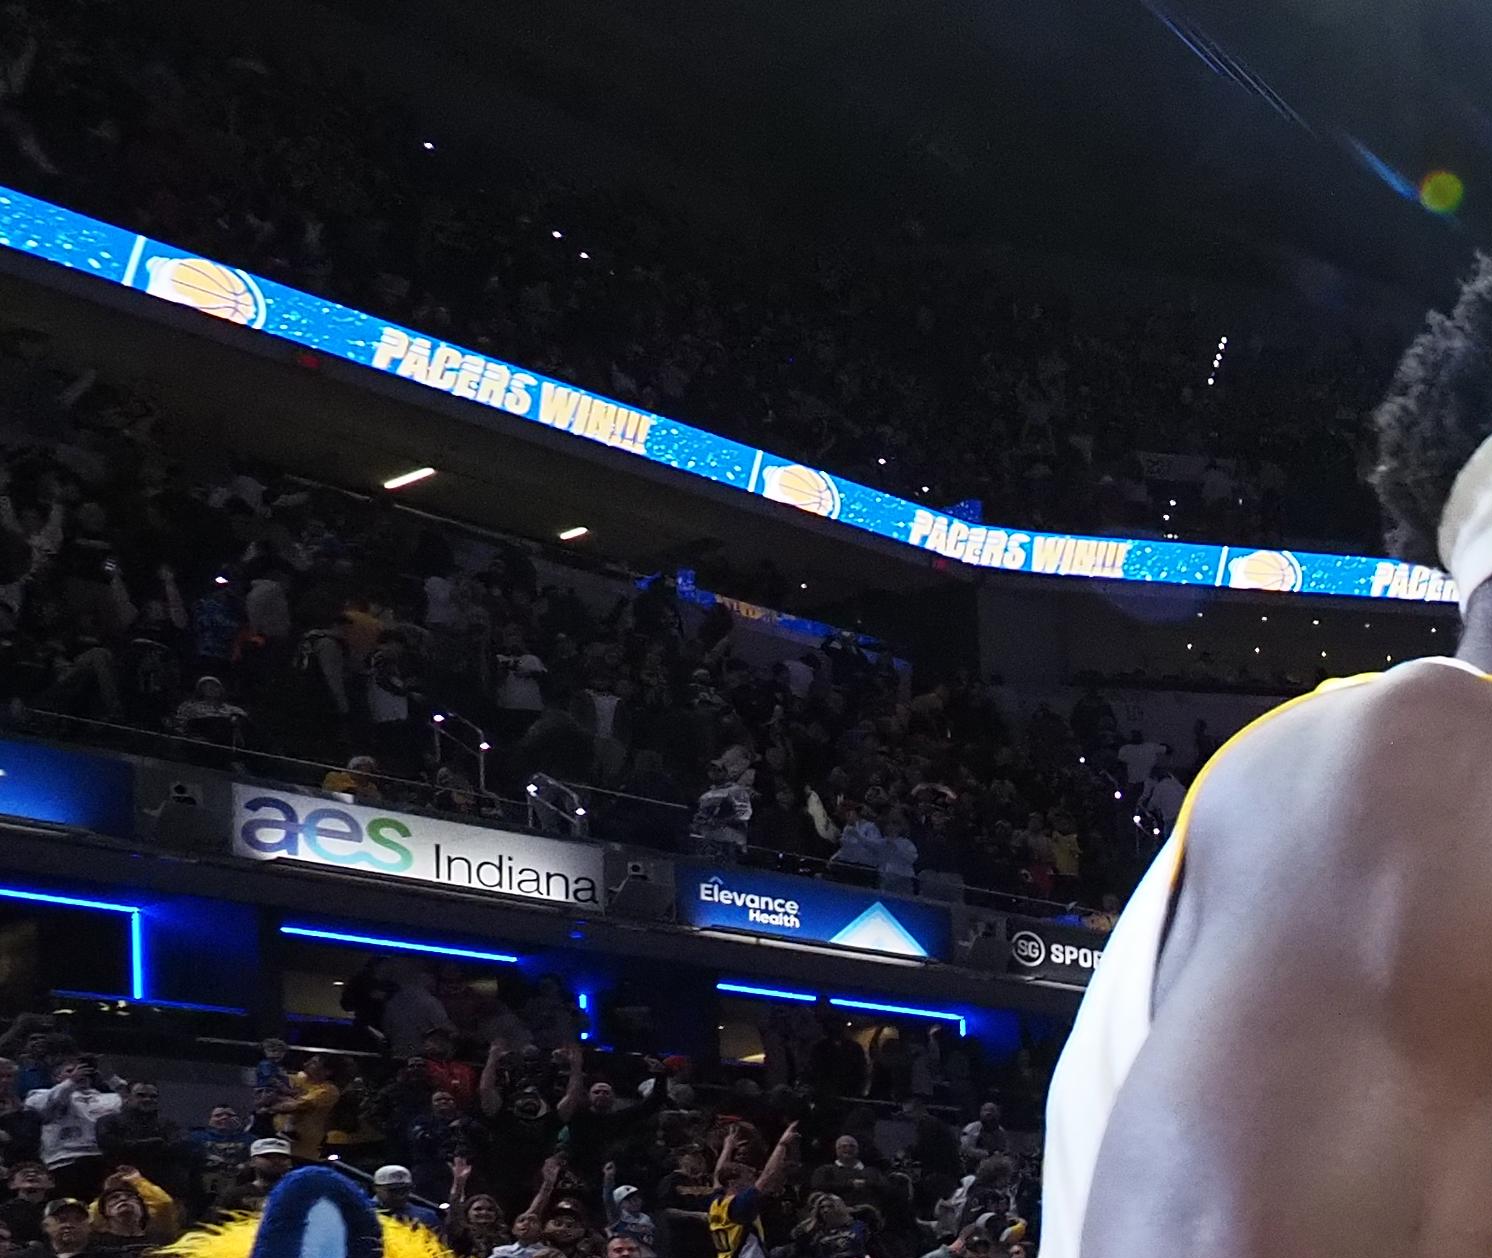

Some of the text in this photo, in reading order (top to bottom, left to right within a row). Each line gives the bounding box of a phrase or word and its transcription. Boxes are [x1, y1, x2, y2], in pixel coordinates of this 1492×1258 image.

[372, 327, 653, 455] PACERS WIN!!!
[908, 509, 1130, 578] PACERS WIN!!!
[241, 796, 600, 904] aes Indiana
[700, 883, 799, 914] Elevance
[749, 909, 800, 928] Health
